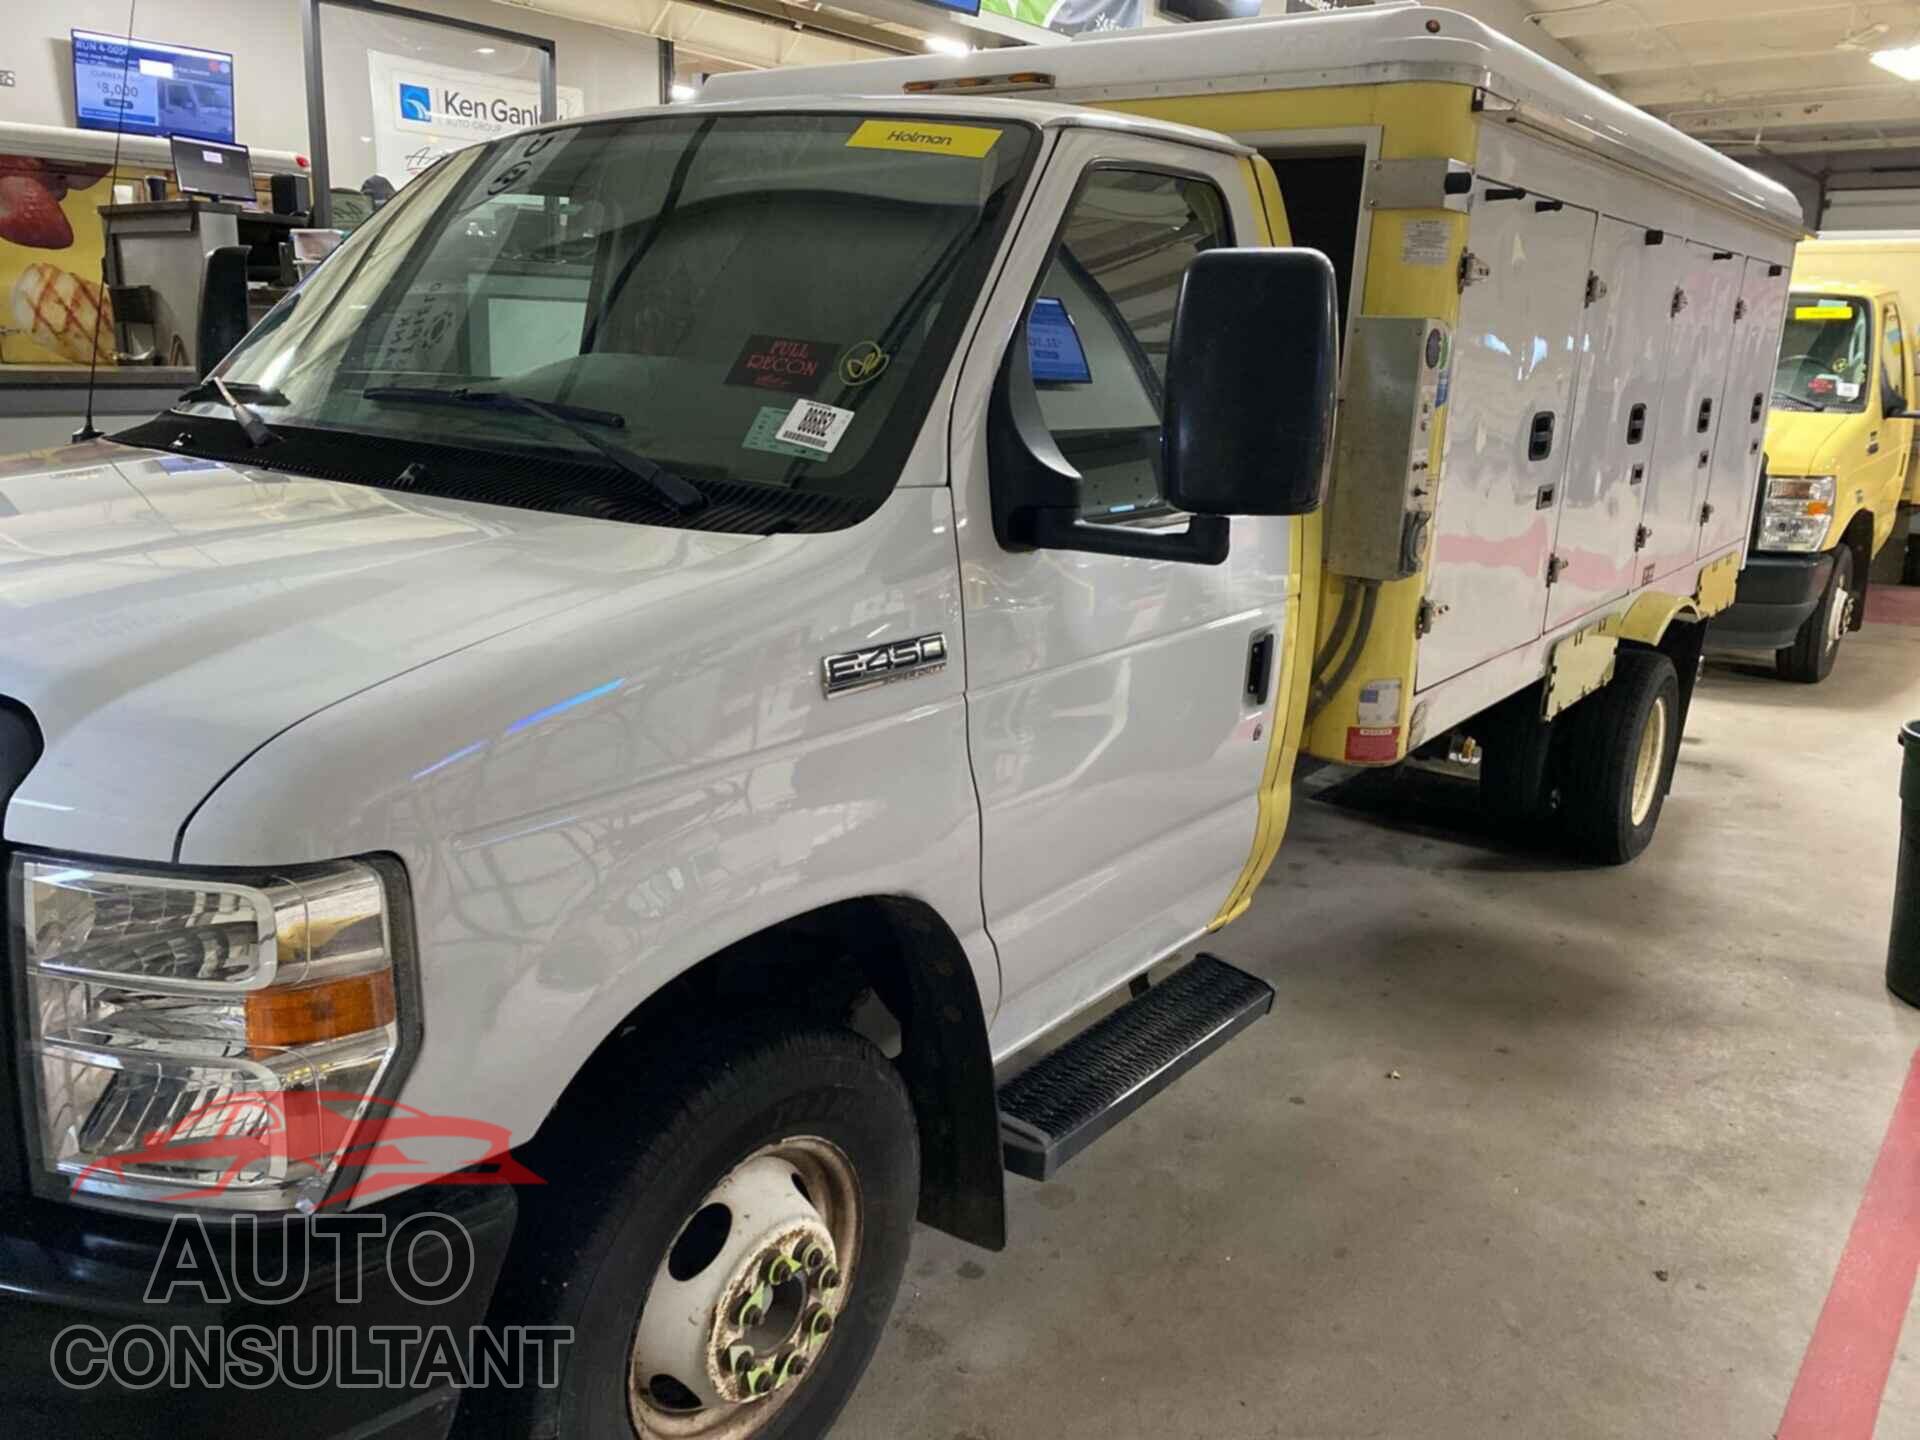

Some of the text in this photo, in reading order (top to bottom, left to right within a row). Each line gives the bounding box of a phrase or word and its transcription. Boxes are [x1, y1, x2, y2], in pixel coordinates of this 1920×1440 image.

[444, 90, 560, 126] Ken Ganl
[887, 130, 953, 146] Holman
[746, 354, 818, 377] RECON
[826, 634, 946, 682] E-450
